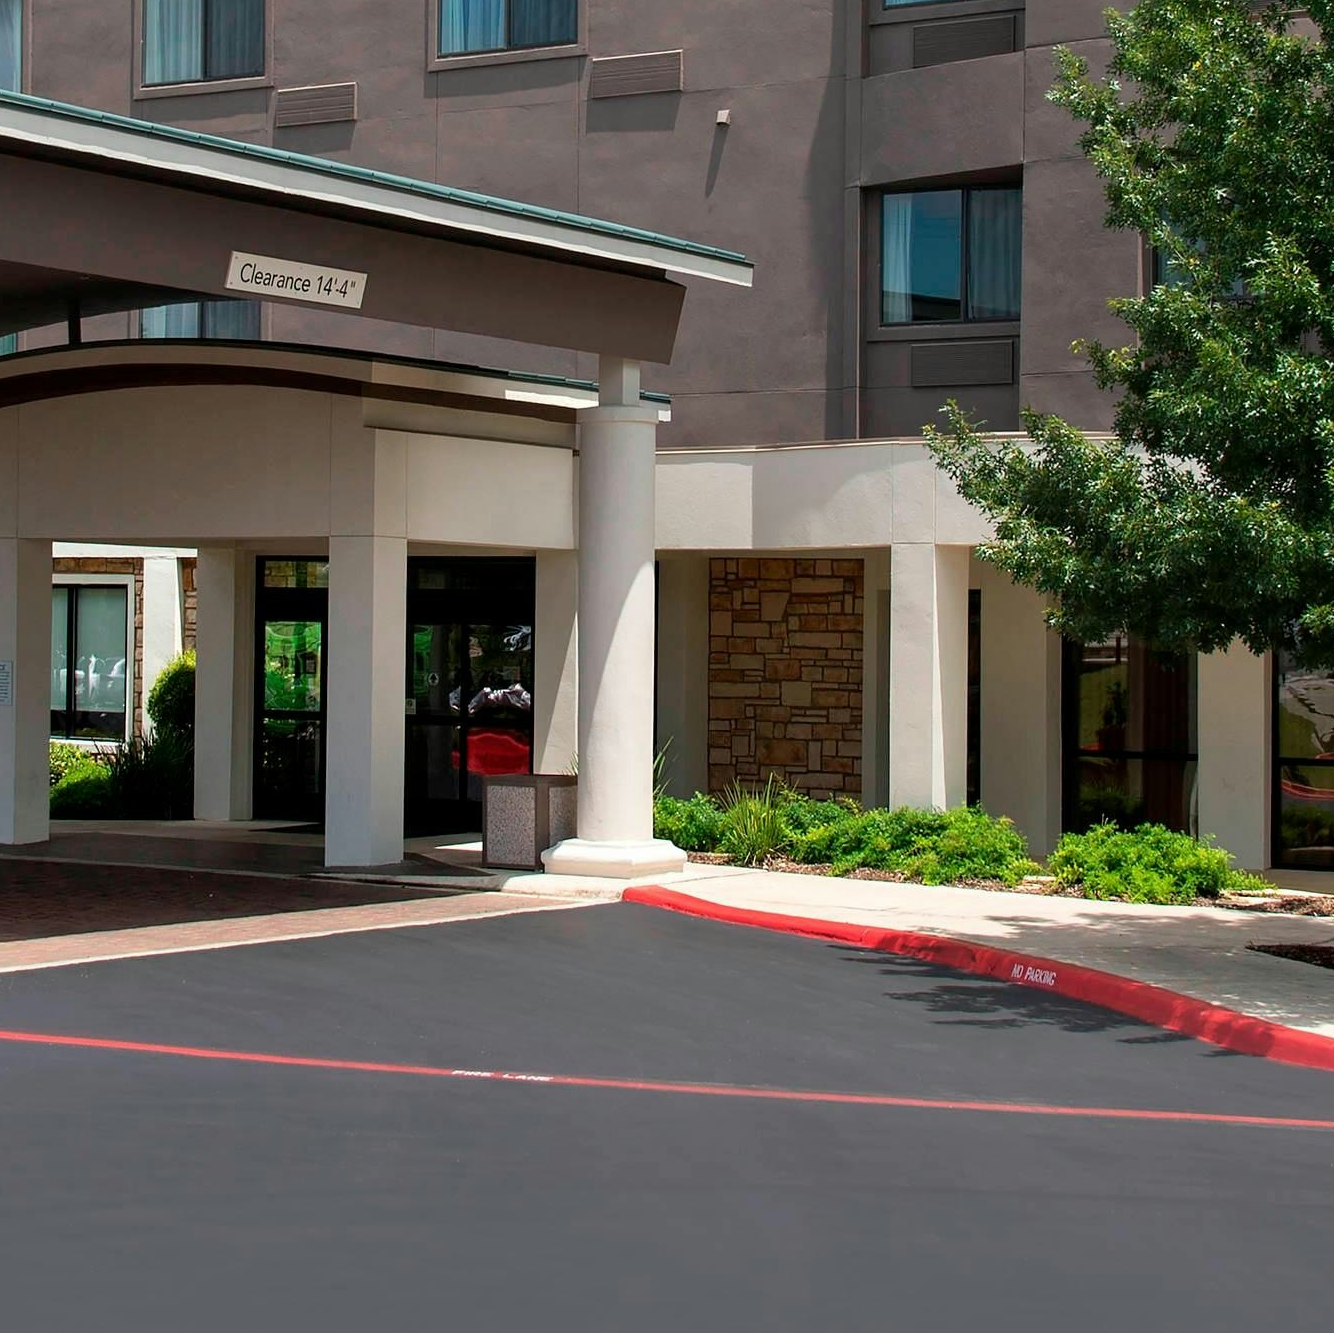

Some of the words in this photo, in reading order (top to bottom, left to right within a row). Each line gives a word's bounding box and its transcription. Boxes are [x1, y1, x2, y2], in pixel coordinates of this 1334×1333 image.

[240, 263, 311, 293] Clearance
[1011, 964, 1024, 979] NO
[1025, 967, 1056, 985] PARKING
[503, 1073, 554, 1082] LANE
